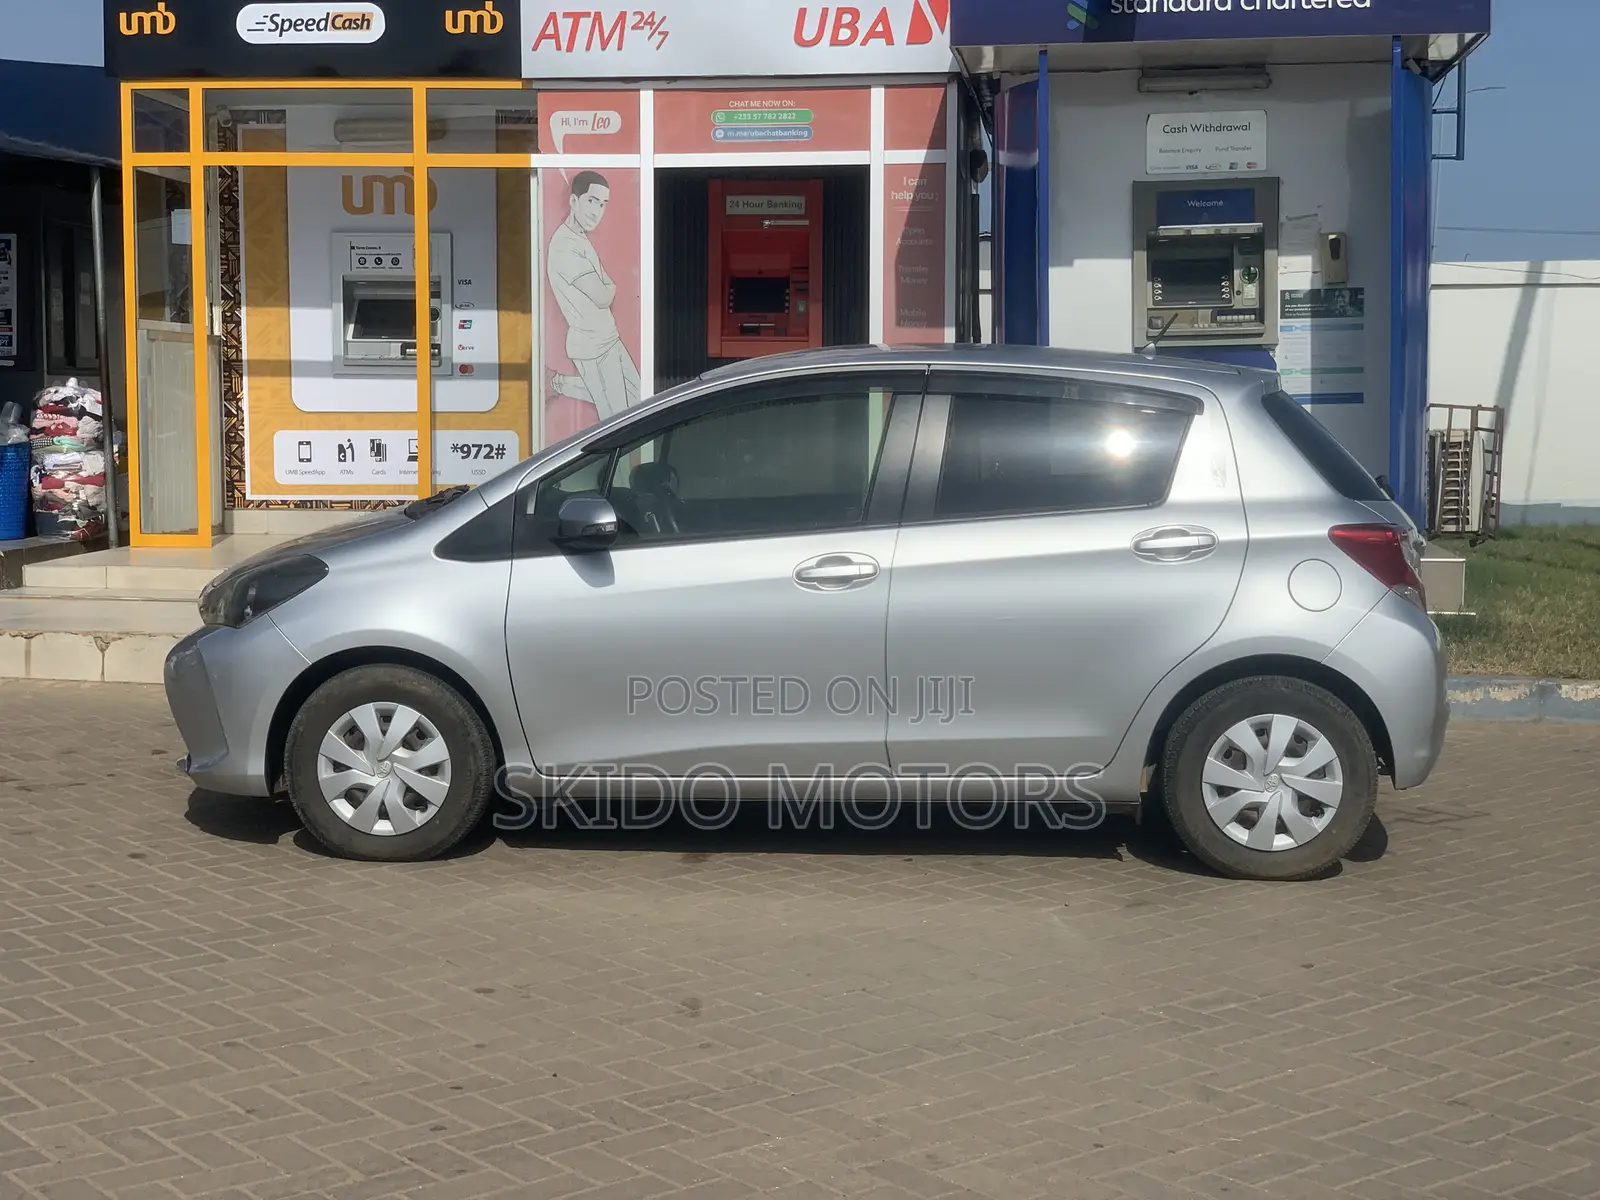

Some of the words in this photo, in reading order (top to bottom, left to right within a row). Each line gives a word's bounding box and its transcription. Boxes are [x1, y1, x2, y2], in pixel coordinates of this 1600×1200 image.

[120, 2, 175, 35] umb
[446, 1, 503, 34] umb
[532, 11, 627, 52] ATM
[631, 11, 669, 51] 24/7
[794, 7, 895, 47] UBA
[561, 118, 572, 127] Hi,
[574, 118, 588, 126] I'm
[591, 112, 610, 131] Leo
[1162, 124, 1188, 134] Cash
[1190, 122, 1251, 133] Withdrawal
[727, 129, 808, 138] m.me/ubachatbanking
[891, 190, 914, 201] help
[767, 200, 803, 210] Banking
[299, 469, 326, 477] SpeedApp
